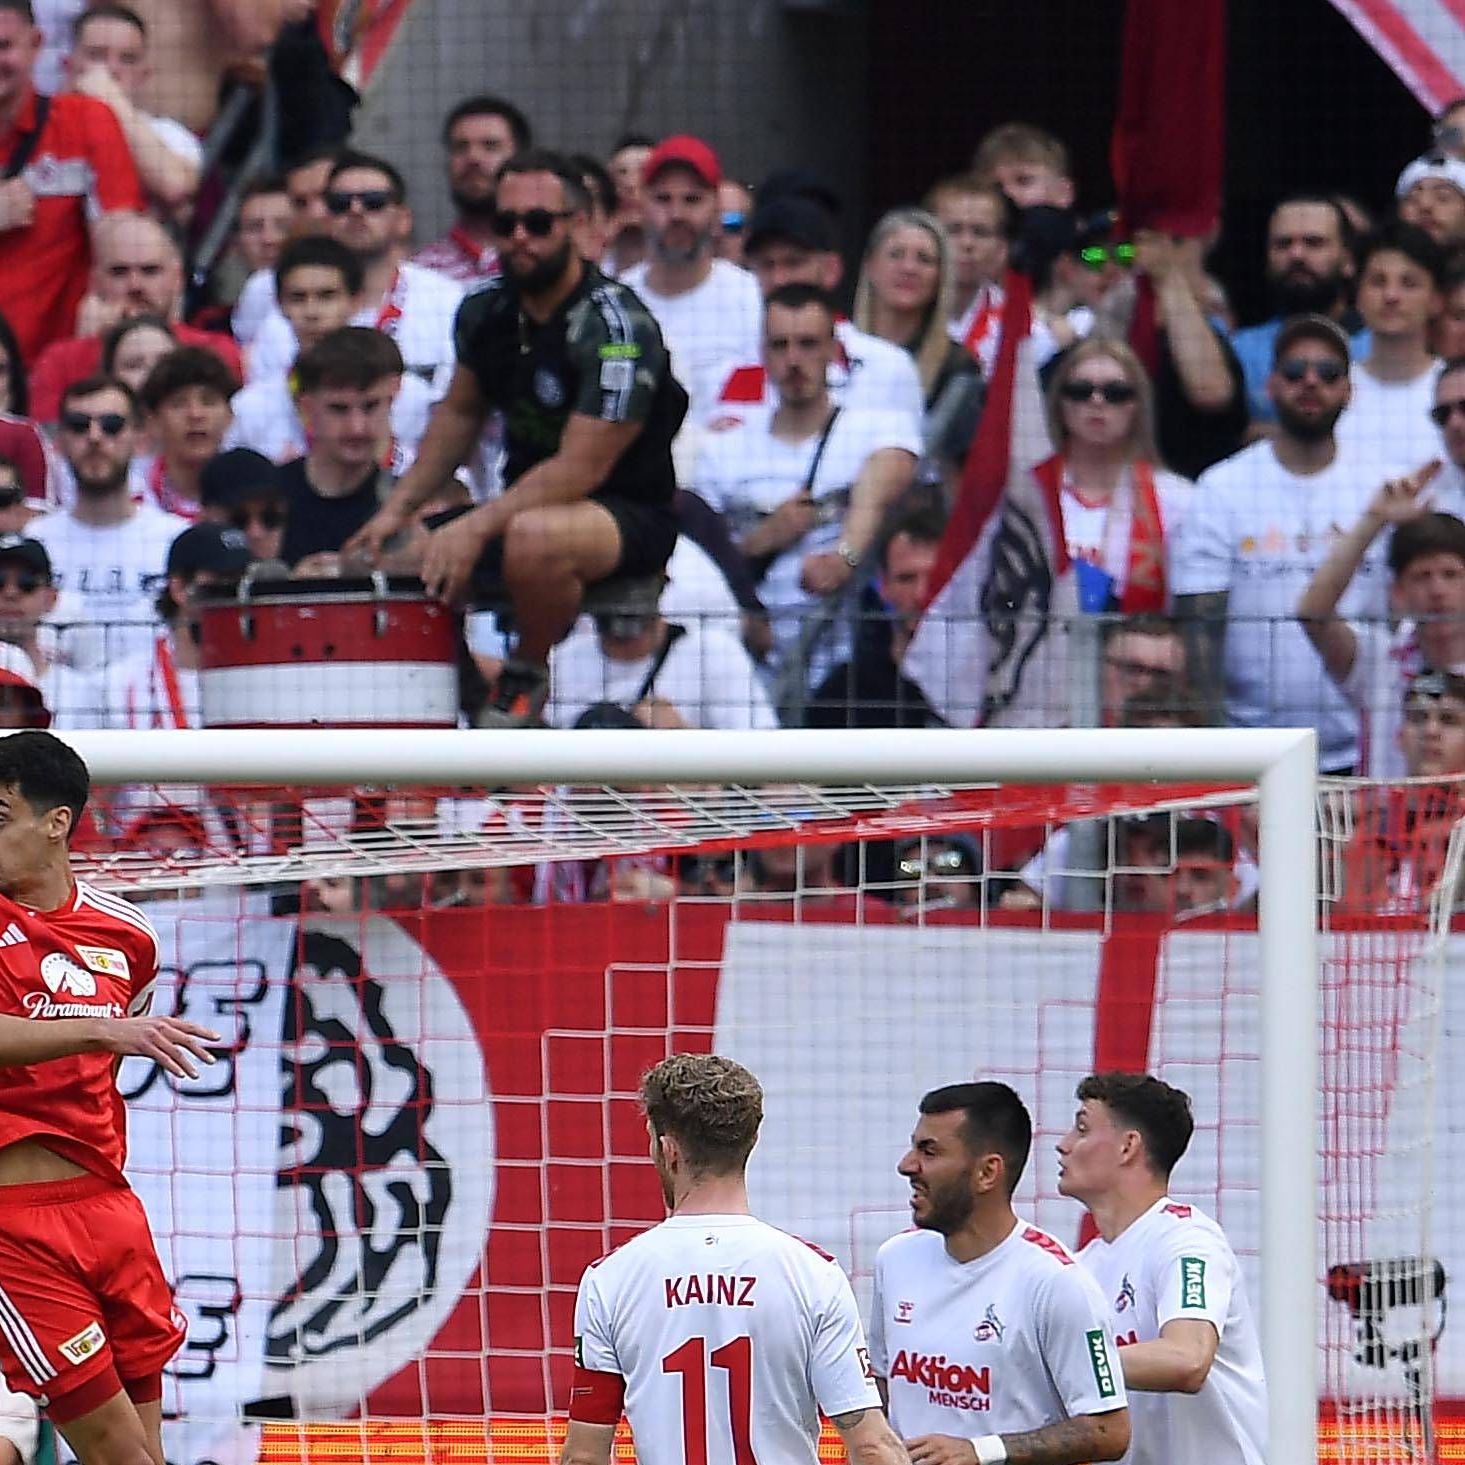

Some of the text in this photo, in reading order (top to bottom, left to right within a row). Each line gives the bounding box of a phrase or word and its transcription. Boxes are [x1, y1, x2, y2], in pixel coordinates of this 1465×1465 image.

[23, 991, 124, 1019] Paramount+
[666, 1274, 757, 1309] KAINZ
[1185, 1261, 1206, 1307] DEVK
[1091, 1336, 1114, 1393] DEVK
[929, 1391, 990, 1411] MENSCH
